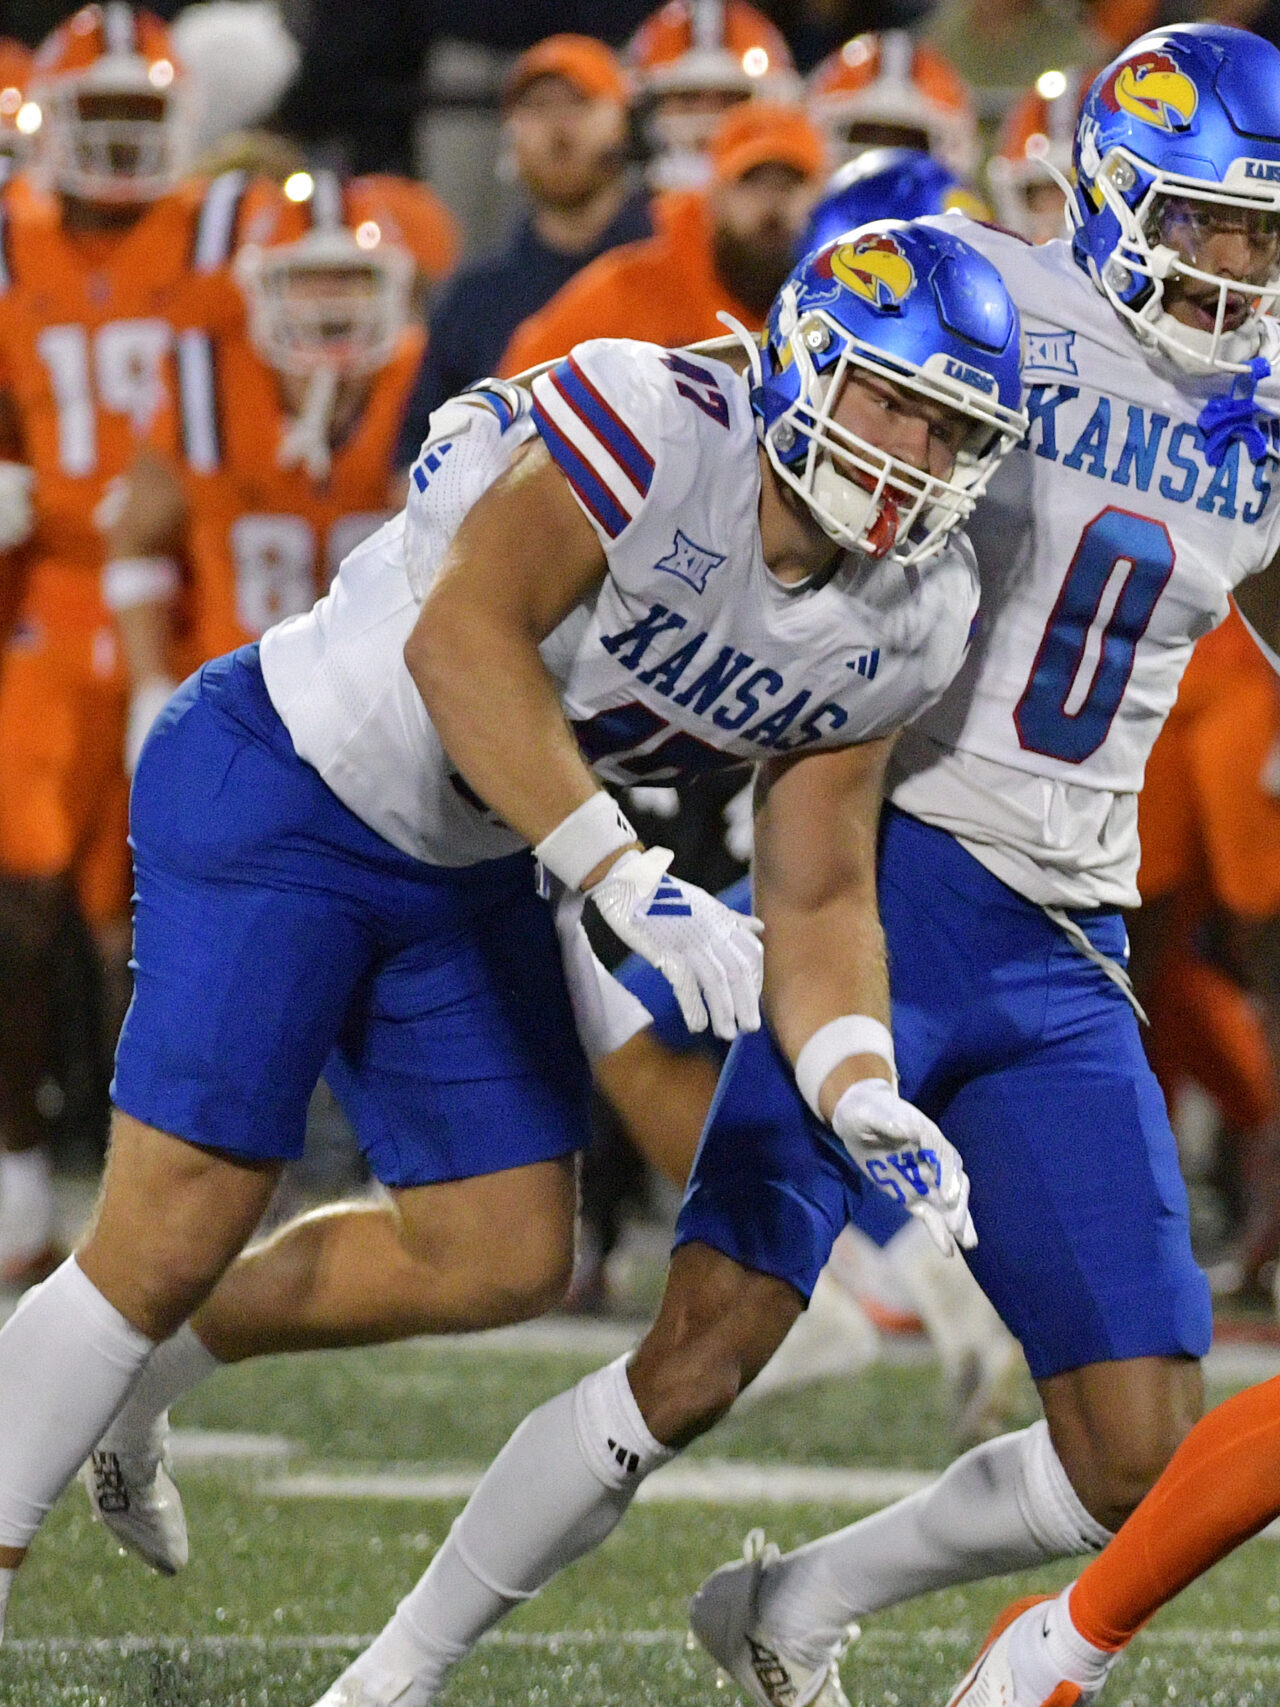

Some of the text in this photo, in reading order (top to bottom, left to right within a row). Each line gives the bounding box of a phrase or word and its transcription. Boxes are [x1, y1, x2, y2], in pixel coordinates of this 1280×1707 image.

[35, 317, 175, 479] 19
[656, 351, 731, 431] 17
[943, 358, 995, 396] KANSAS
[1014, 383, 1280, 525] KANSAS
[599, 602, 849, 750] KANSAS
[1012, 504, 1178, 765] 0
